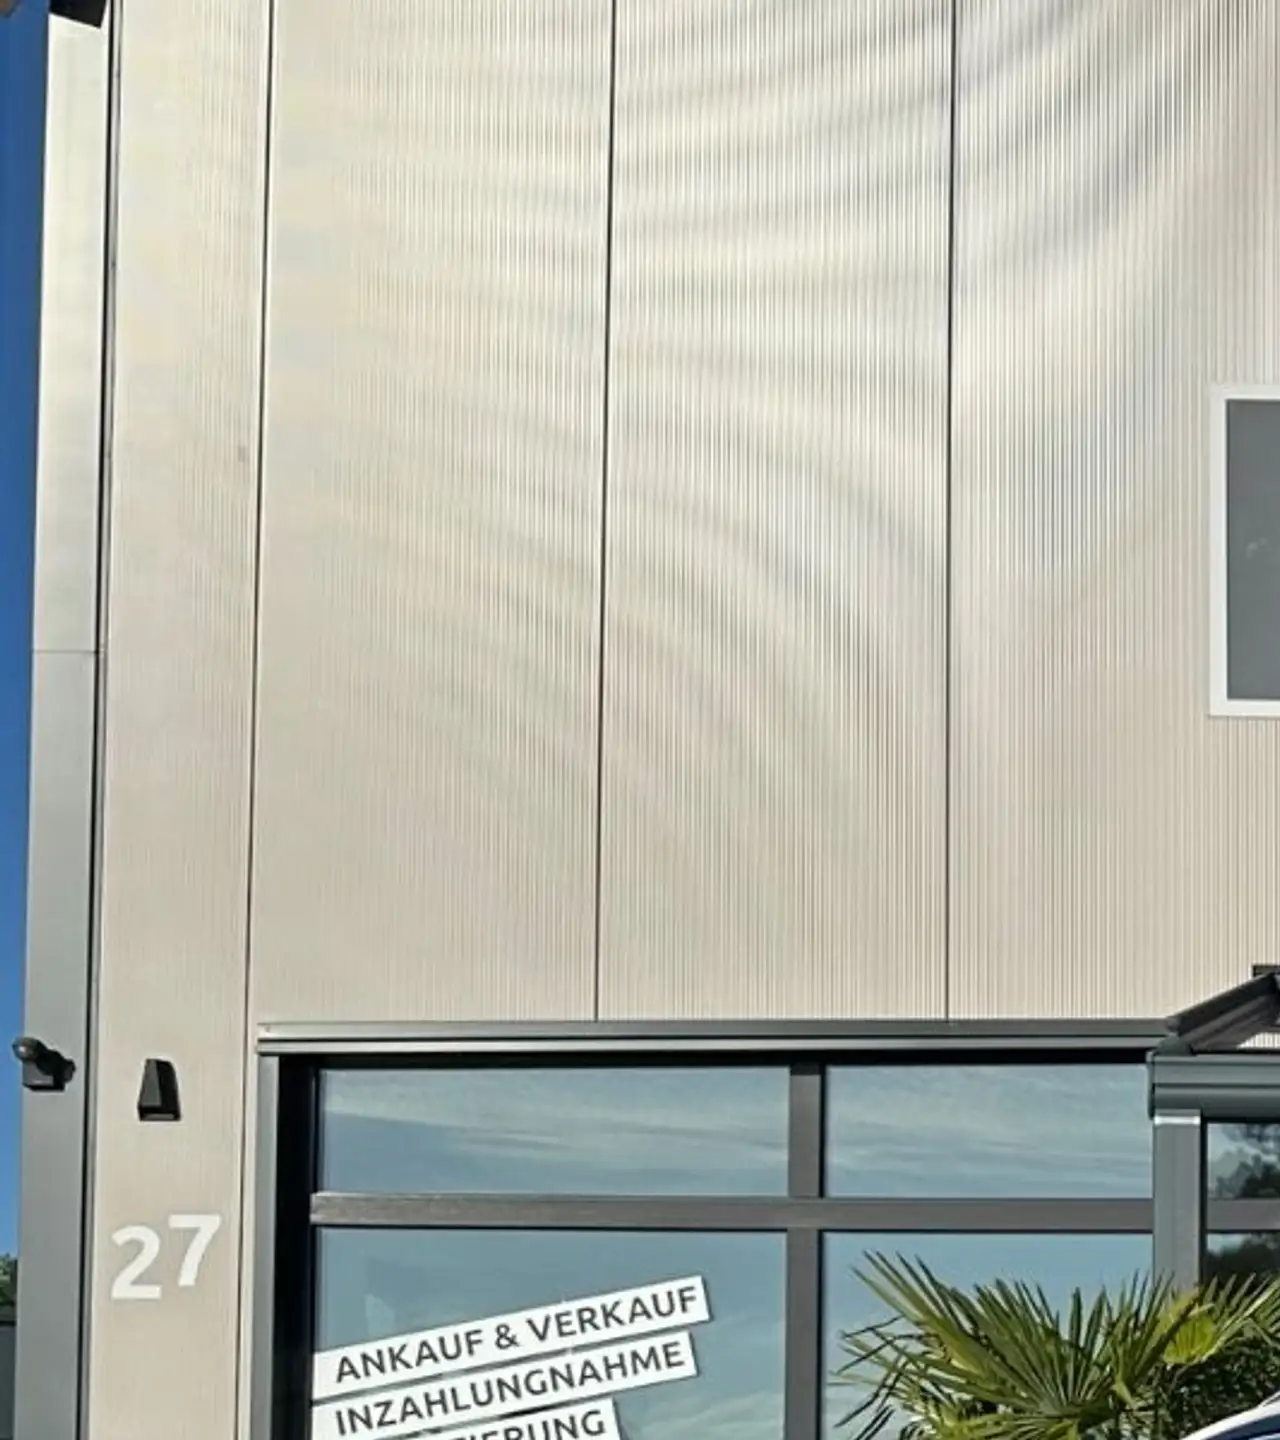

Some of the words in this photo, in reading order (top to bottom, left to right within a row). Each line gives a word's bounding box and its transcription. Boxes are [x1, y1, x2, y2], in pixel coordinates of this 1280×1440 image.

[110, 1213, 222, 1300] 27
[335, 1329, 486, 1383] ANKAUF
[494, 1323, 519, 1350] &
[527, 1286, 699, 1344] VERKAUF
[336, 1341, 685, 1436] INZAHLUNGNAHME
